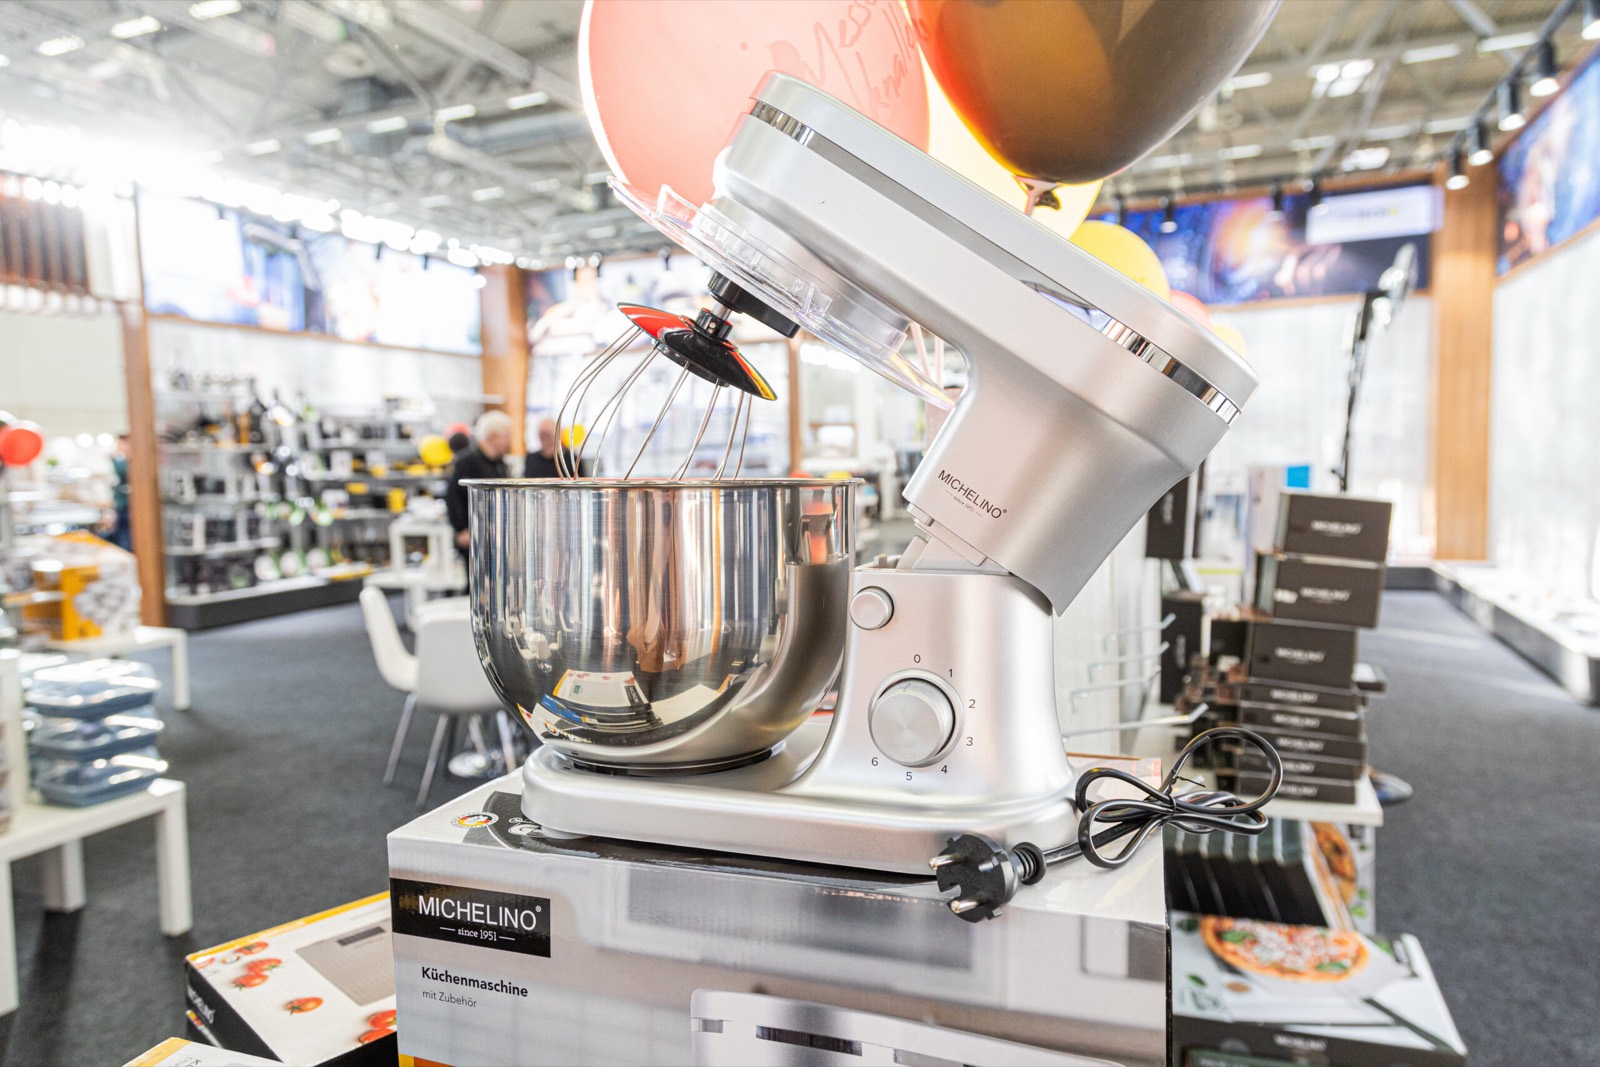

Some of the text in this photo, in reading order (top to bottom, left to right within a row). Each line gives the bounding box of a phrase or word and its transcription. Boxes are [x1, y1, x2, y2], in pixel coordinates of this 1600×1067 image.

[913, 653, 921, 664] 0
[968, 698, 976, 709] 2
[965, 736, 973, 747] 3
[871, 756, 879, 767] 6
[940, 764, 948, 775] 4
[905, 771, 913, 781] 5
[457, 927, 497, 941] since 1951
[421, 966, 529, 998] Küchenmaschine
[422, 989, 477, 1008] mit Zubehör
